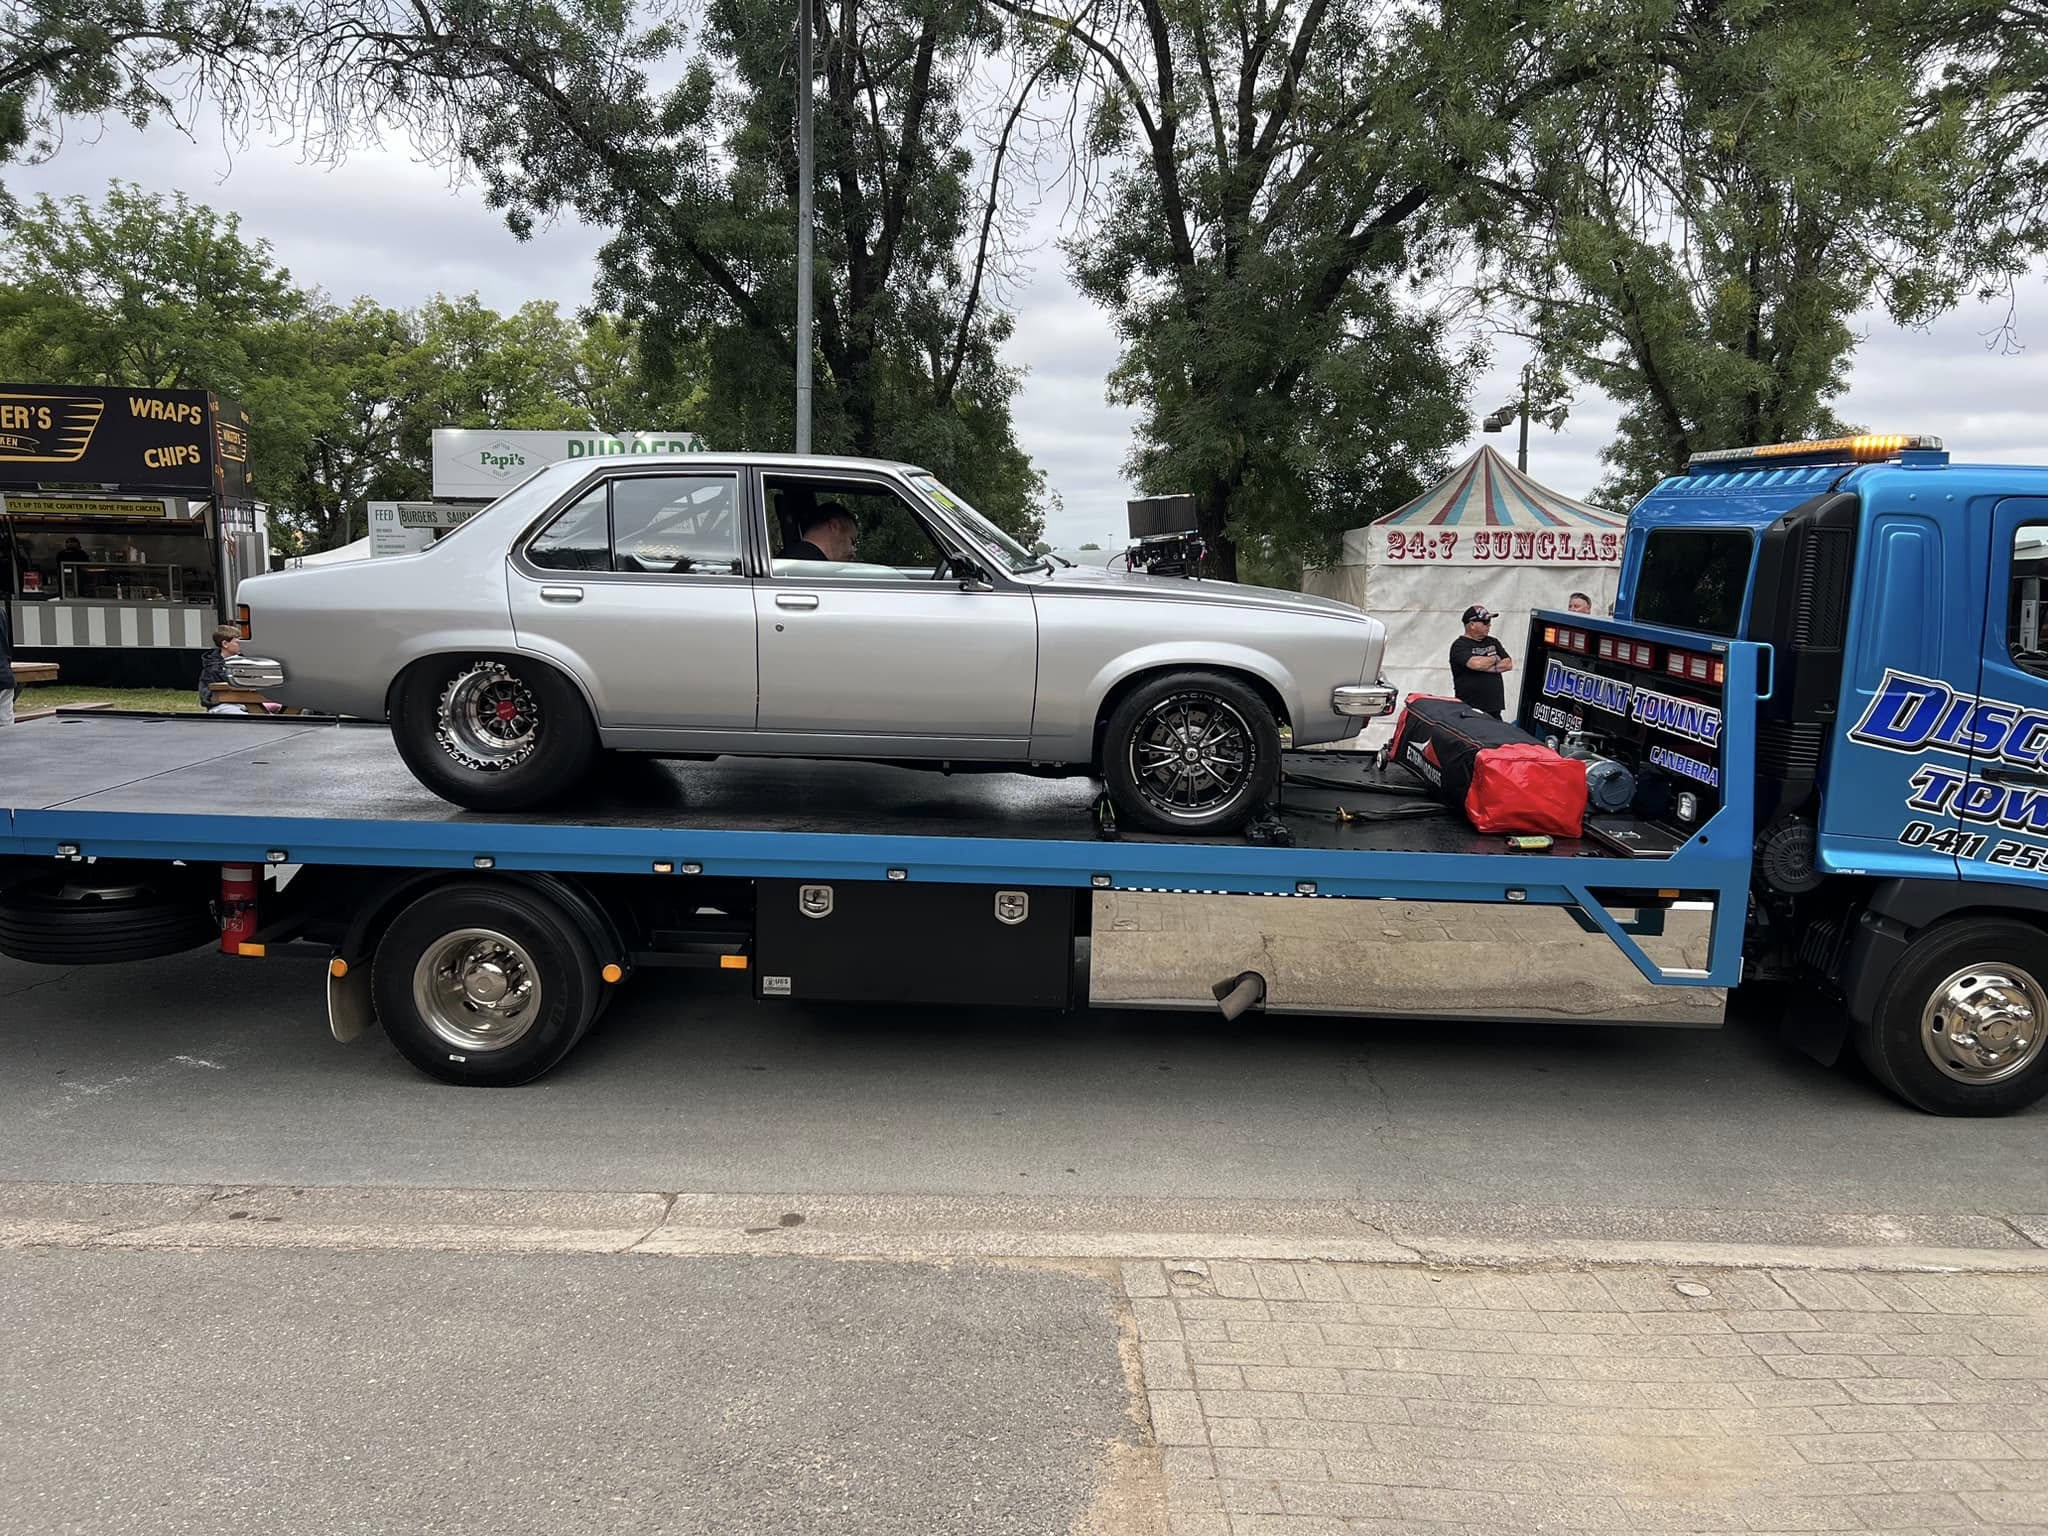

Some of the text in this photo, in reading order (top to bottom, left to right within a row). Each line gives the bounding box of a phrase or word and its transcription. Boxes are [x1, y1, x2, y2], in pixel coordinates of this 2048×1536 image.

[128, 396, 202, 425] WRAPS
[144, 444, 201, 468] CHIPS
[480, 451, 525, 470] Papi's
[375, 509, 394, 521] FEED
[400, 510, 438, 523] BURGERS
[1387, 530, 1625, 561] 24:7 SUNGLAS
[1544, 658, 1723, 749] DISCOUNT TOWING
[1847, 667, 2048, 773] DISC
[1650, 746, 1720, 788] CANBERRA
[1898, 821, 1988, 861] 0411
